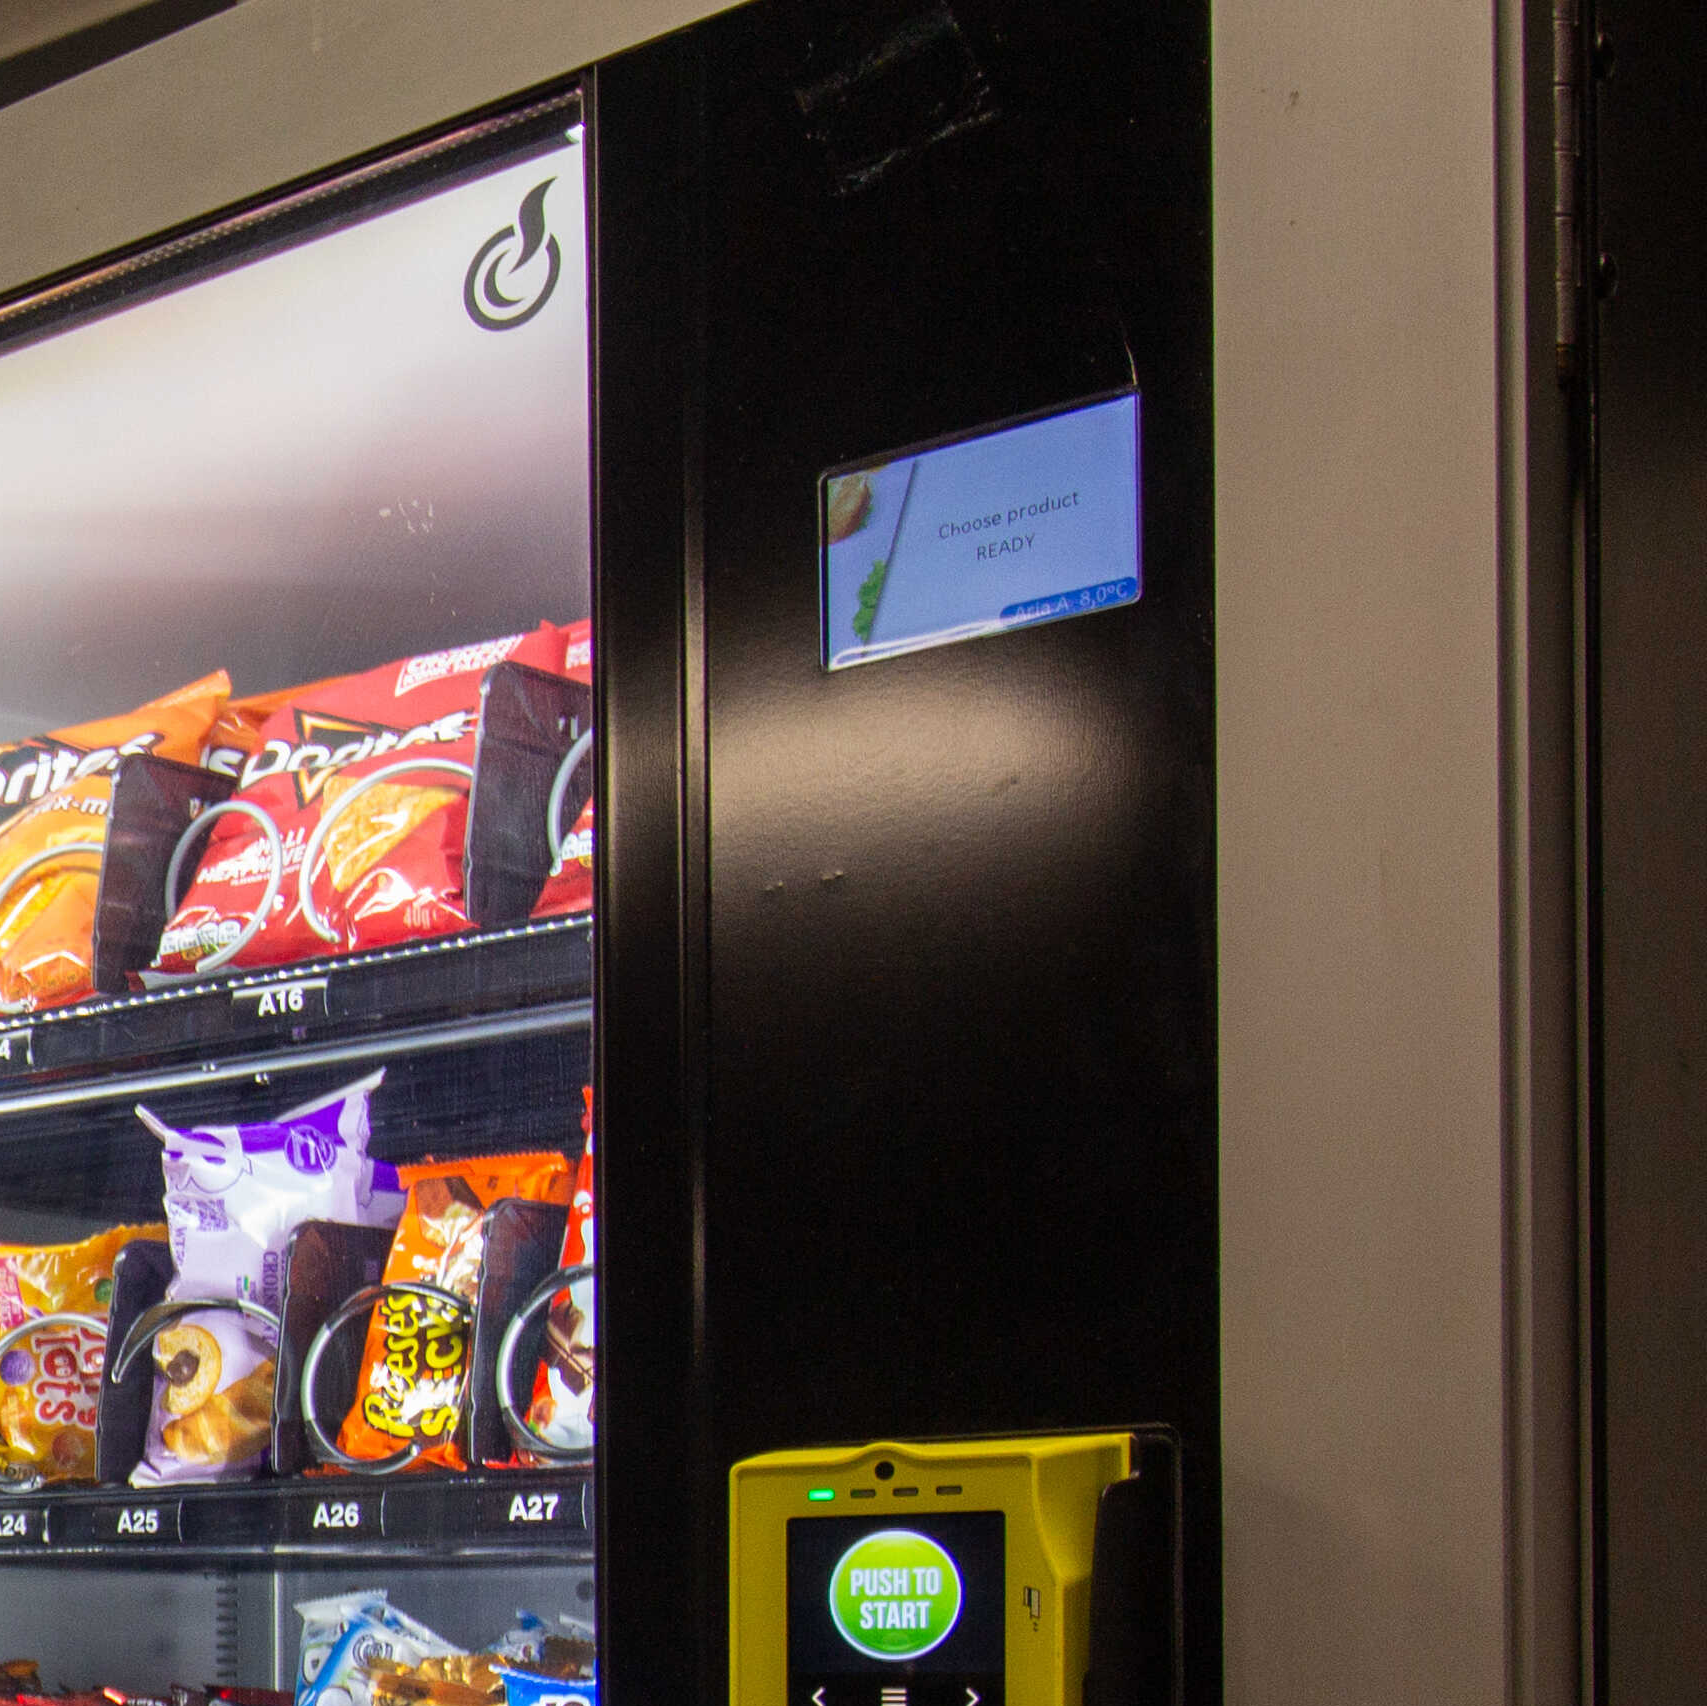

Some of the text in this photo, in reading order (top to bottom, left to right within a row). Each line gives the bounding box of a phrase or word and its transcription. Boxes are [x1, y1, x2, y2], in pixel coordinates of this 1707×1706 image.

[938, 490, 1080, 541] Choose product
[975, 534, 1036, 561] READY
[258, 987, 306, 1016] A16
[33, 1333, 81, 1425] Tots
[116, 1510, 159, 1534] A25
[313, 1504, 360, 1528] A26
[508, 1496, 559, 1522] A27
[850, 1567, 942, 1598] PUSH TO
[859, 1601, 931, 1631] START
